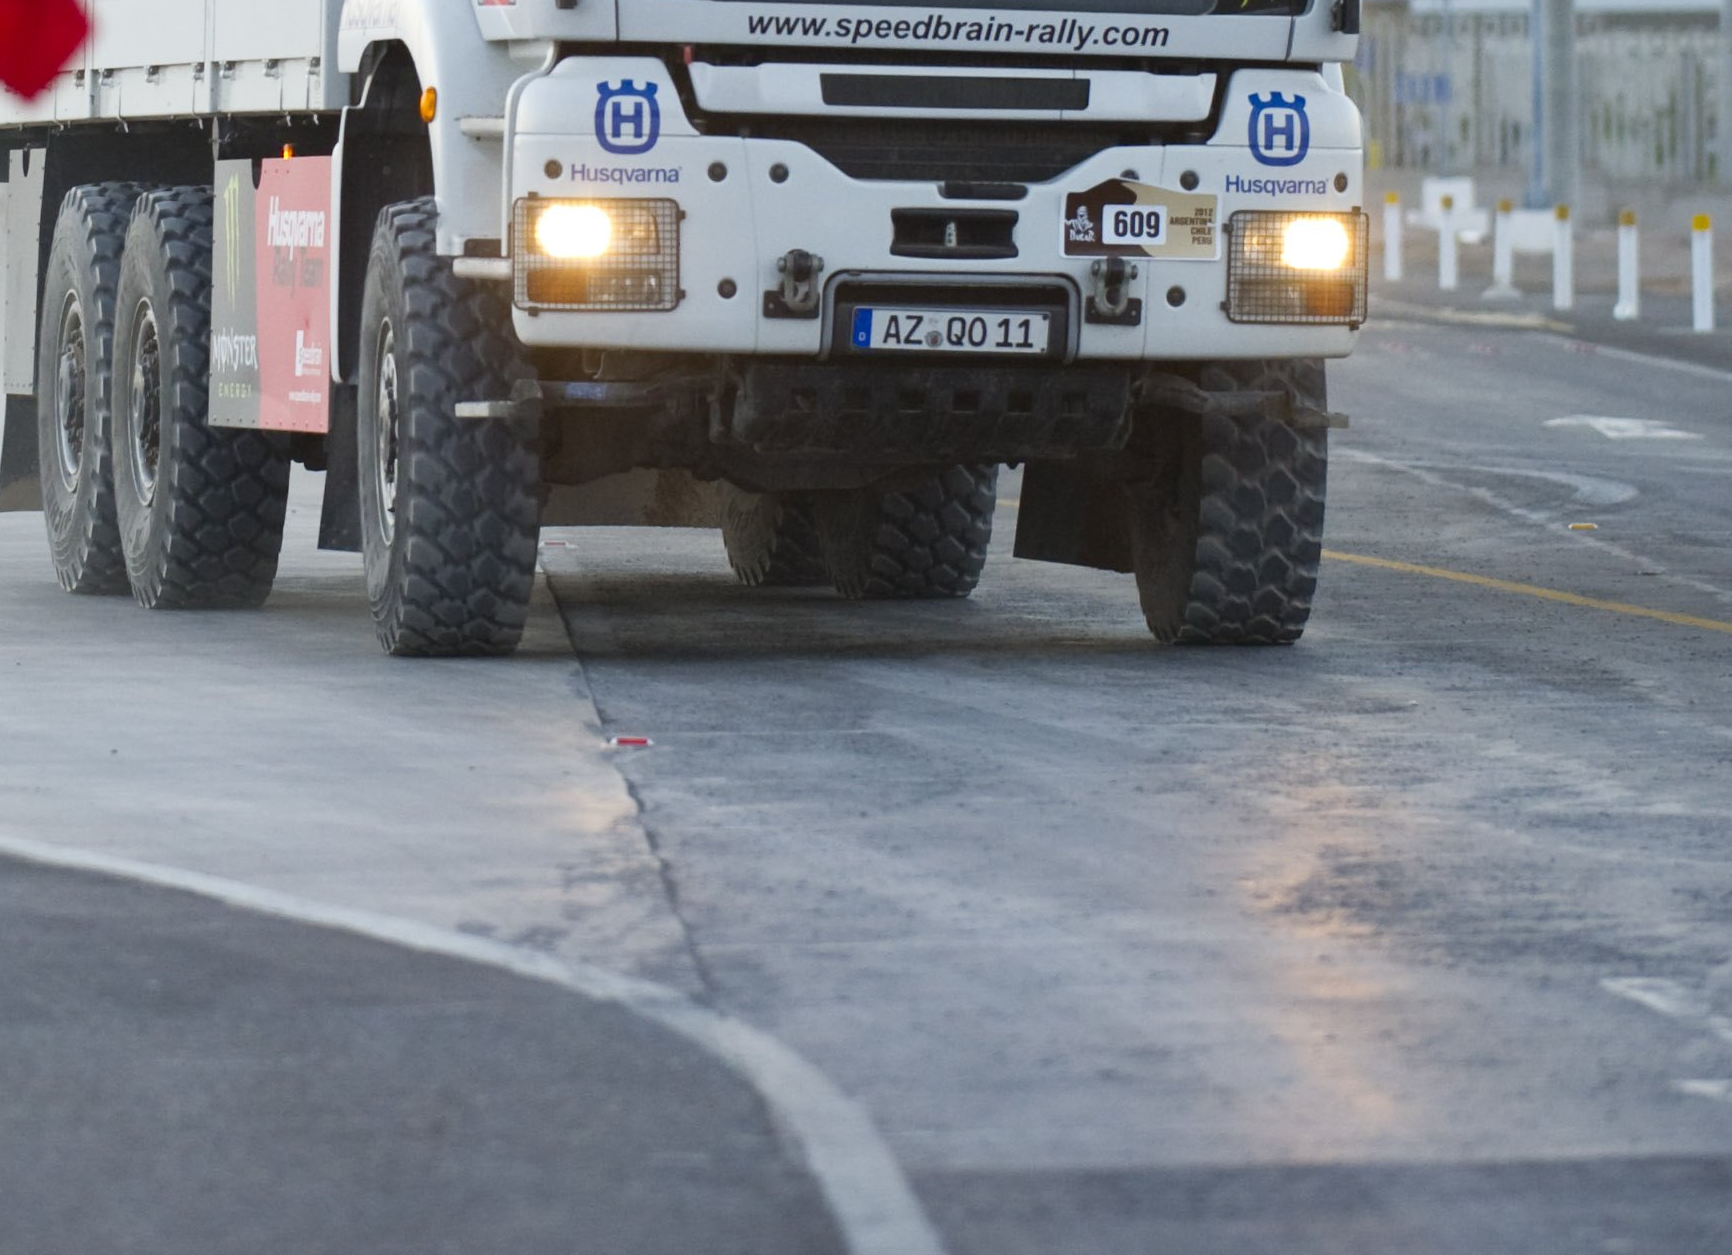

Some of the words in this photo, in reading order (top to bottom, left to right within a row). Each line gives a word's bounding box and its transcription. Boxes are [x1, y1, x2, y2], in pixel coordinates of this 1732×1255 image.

[748, 14, 1170, 51] www.speedbrain-rally.com
[571, 164, 679, 185] Husqvarna
[1225, 175, 1326, 196] Husqvarna
[268, 196, 325, 261] Husqvarna
[1114, 210, 1160, 238] 609
[1190, 227, 1212, 235] CHILE
[1192, 236, 1212, 245] PERU
[882, 315, 924, 345] AZ
[946, 317, 988, 347] QO
[995, 318, 1034, 348] 11
[219, 382, 252, 398] ENERGY
